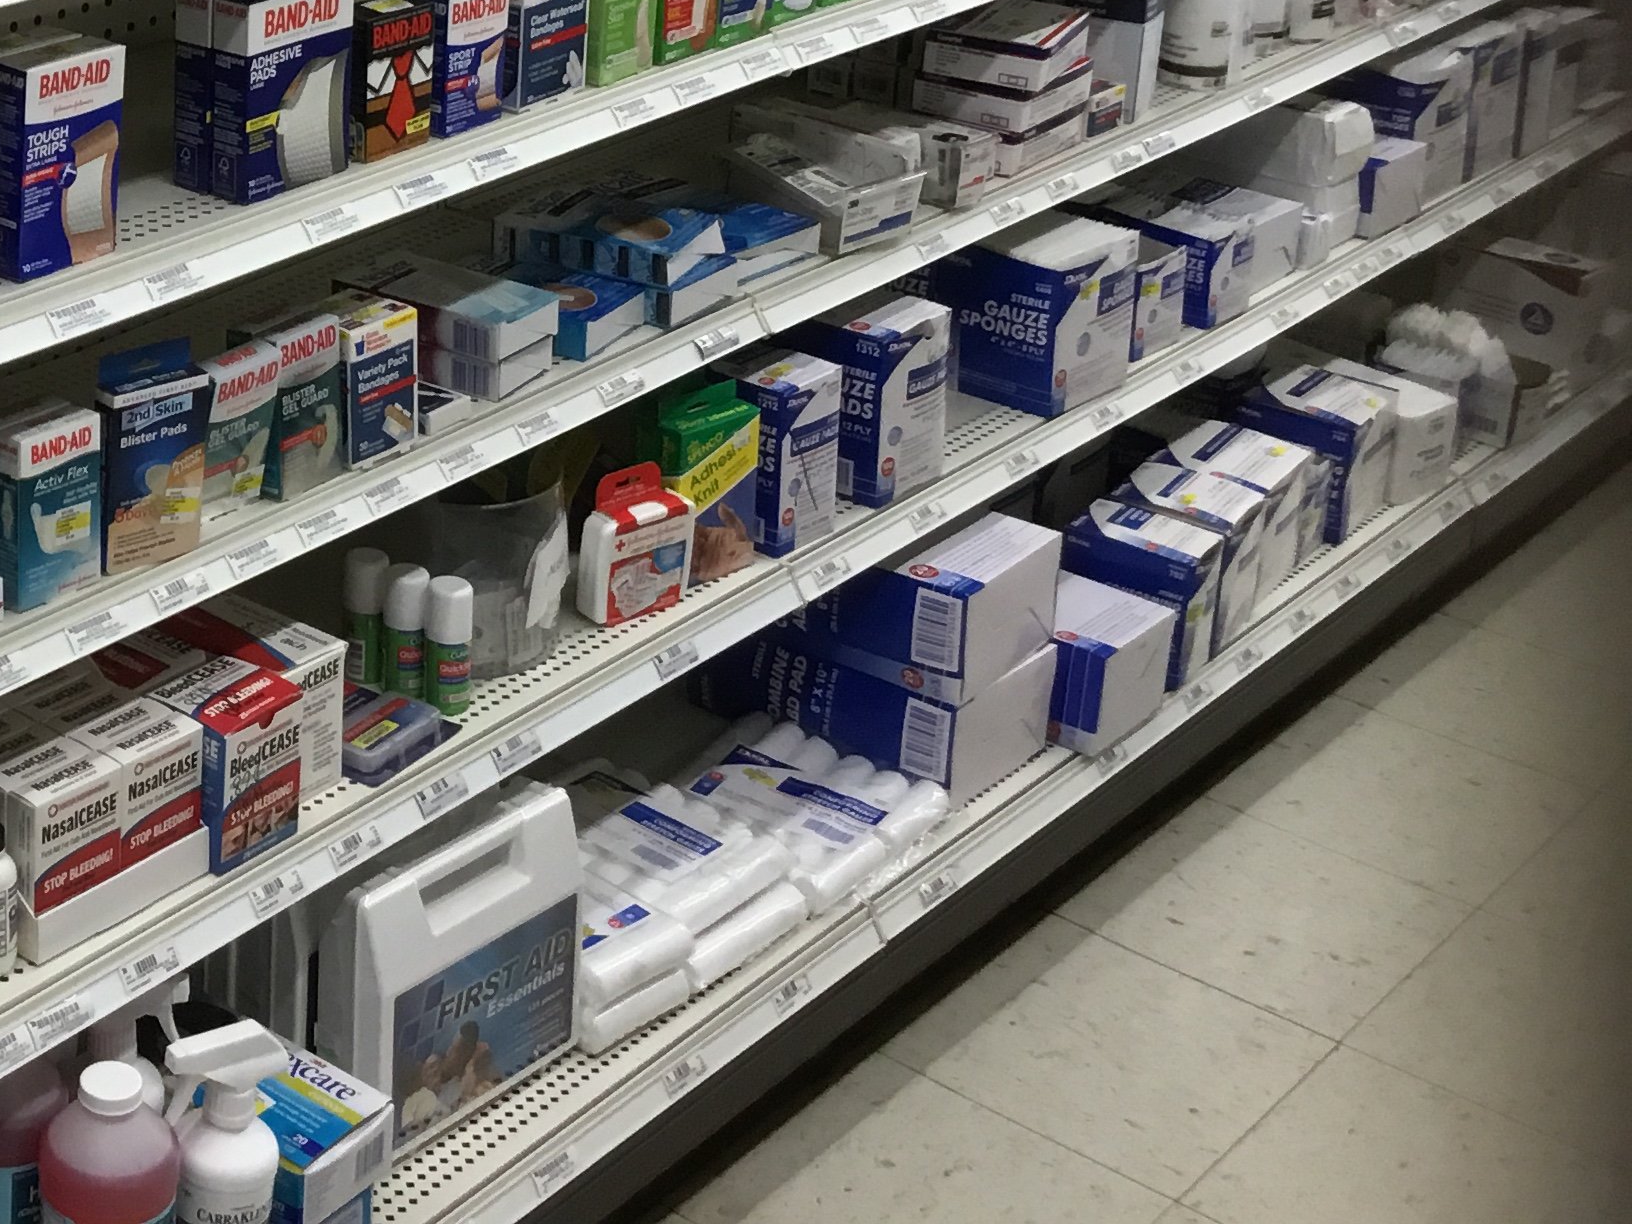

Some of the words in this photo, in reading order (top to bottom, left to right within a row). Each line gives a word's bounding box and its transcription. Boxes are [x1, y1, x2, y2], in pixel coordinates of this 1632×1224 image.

[372, 12, 432, 49] BAND-AID
[250, 44, 302, 70] ADHESIVE
[250, 65, 277, 84] PADS
[39, 60, 111, 99] BAND-AID
[27, 126, 68, 149] TOUGH
[27, 141, 66, 162] STRIPS
[985, 301, 1048, 328] GAUZE
[1010, 293, 1050, 309] STERILE
[282, 326, 336, 367] BAND-AID
[961, 311, 1048, 347] SPONGES
[218, 360, 278, 403] BAND-AID
[126, 405, 152, 426] 2nd
[155, 400, 184, 418] Skin
[31, 428, 91, 465] BAND-AID
[120, 428, 157, 449] Blister
[160, 423, 187, 440] Pads
[694, 479, 721, 504] Knit
[230, 727, 300, 779] BleedCEASE
[42, 795, 117, 845] NasalCEASE
[44, 867, 71, 895] STOP
[70, 848, 114, 881] BLEEDING!
[439, 960, 518, 1030] FIRST
[525, 931, 567, 973] AID
[487, 961, 564, 1017] Essentials
